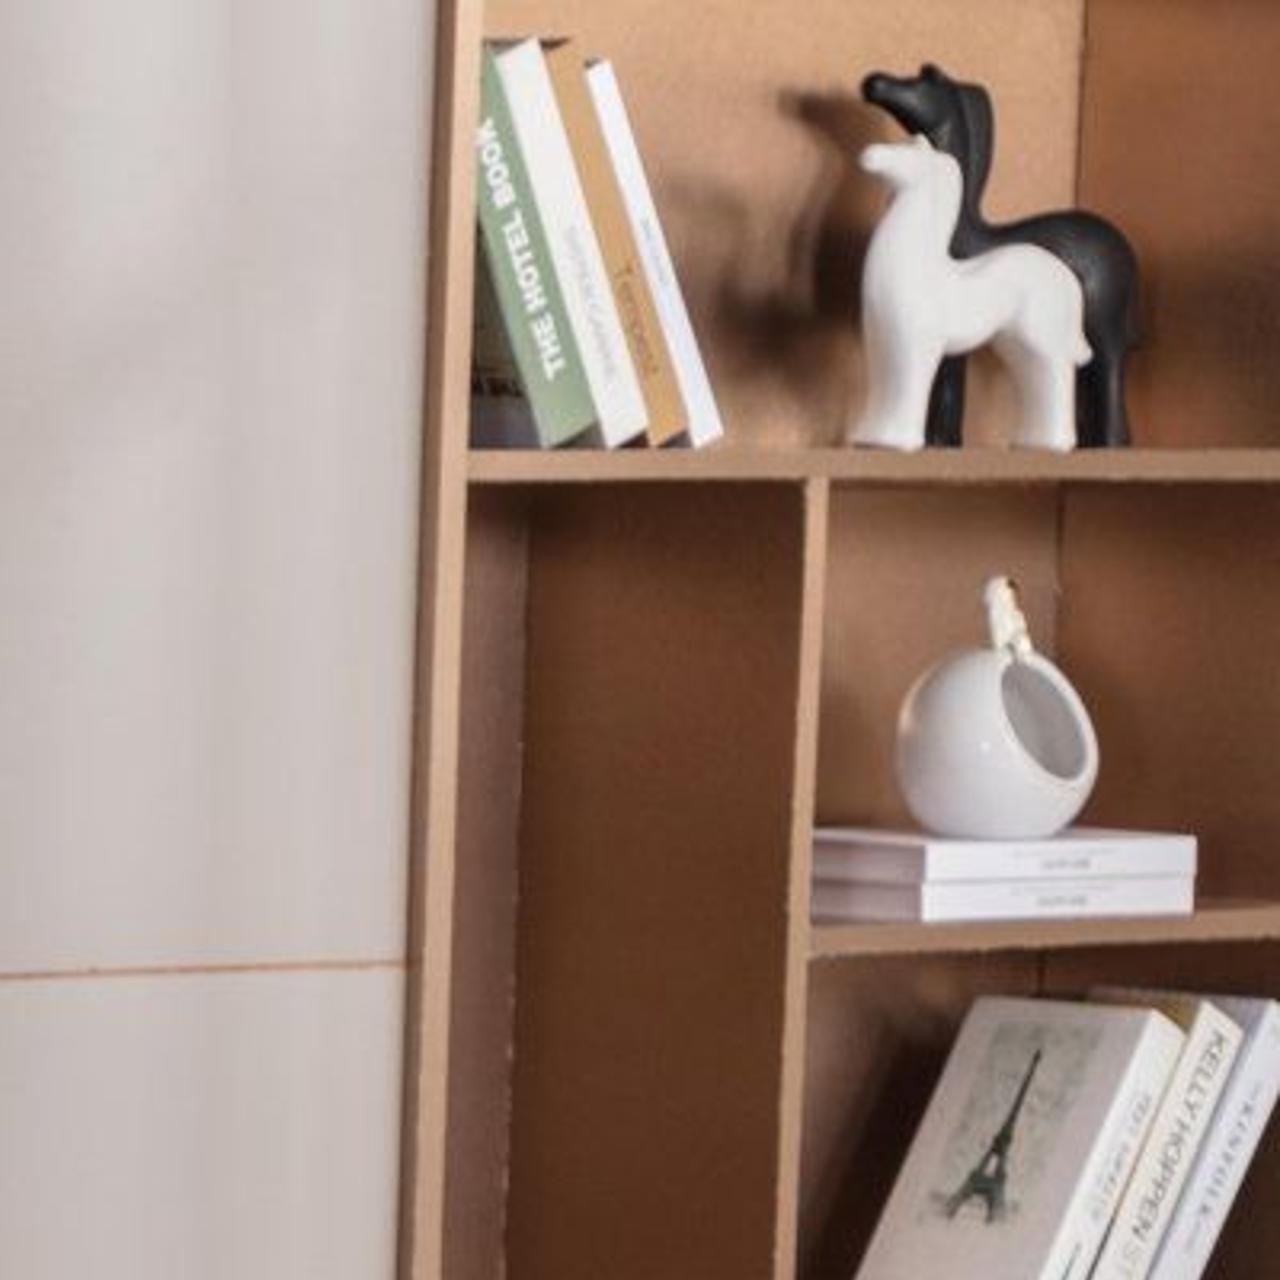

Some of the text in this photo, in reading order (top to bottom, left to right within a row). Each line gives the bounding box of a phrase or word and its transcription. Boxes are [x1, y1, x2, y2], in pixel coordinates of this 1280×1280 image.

[502, 209, 548, 314] HOTEL
[532, 313, 566, 381] THE
[1186, 1030, 1226, 1120] KELLY
[1132, 1119, 1190, 1240] HOPPEN
